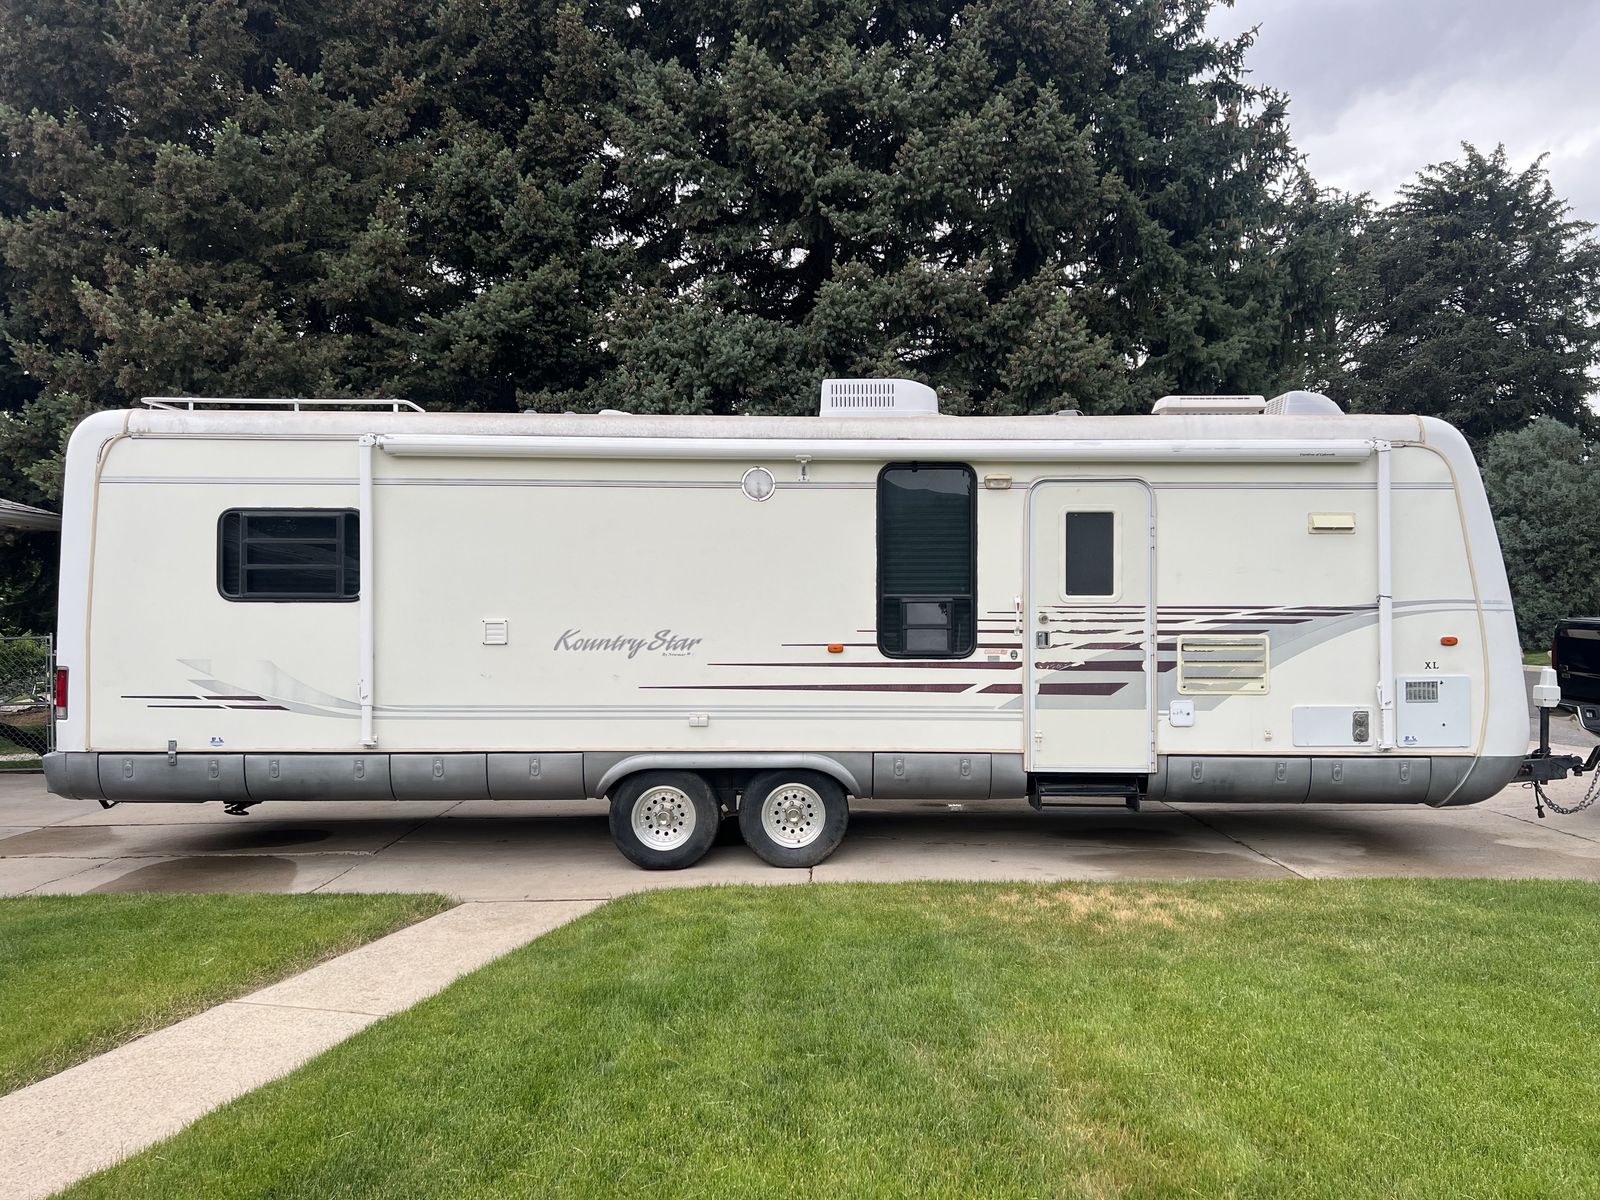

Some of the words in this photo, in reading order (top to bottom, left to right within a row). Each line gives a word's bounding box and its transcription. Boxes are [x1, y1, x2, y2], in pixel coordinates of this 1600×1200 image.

[553, 628, 648, 660] Kountry
[647, 628, 703, 651] Star
[1424, 661, 1440, 669] XL
